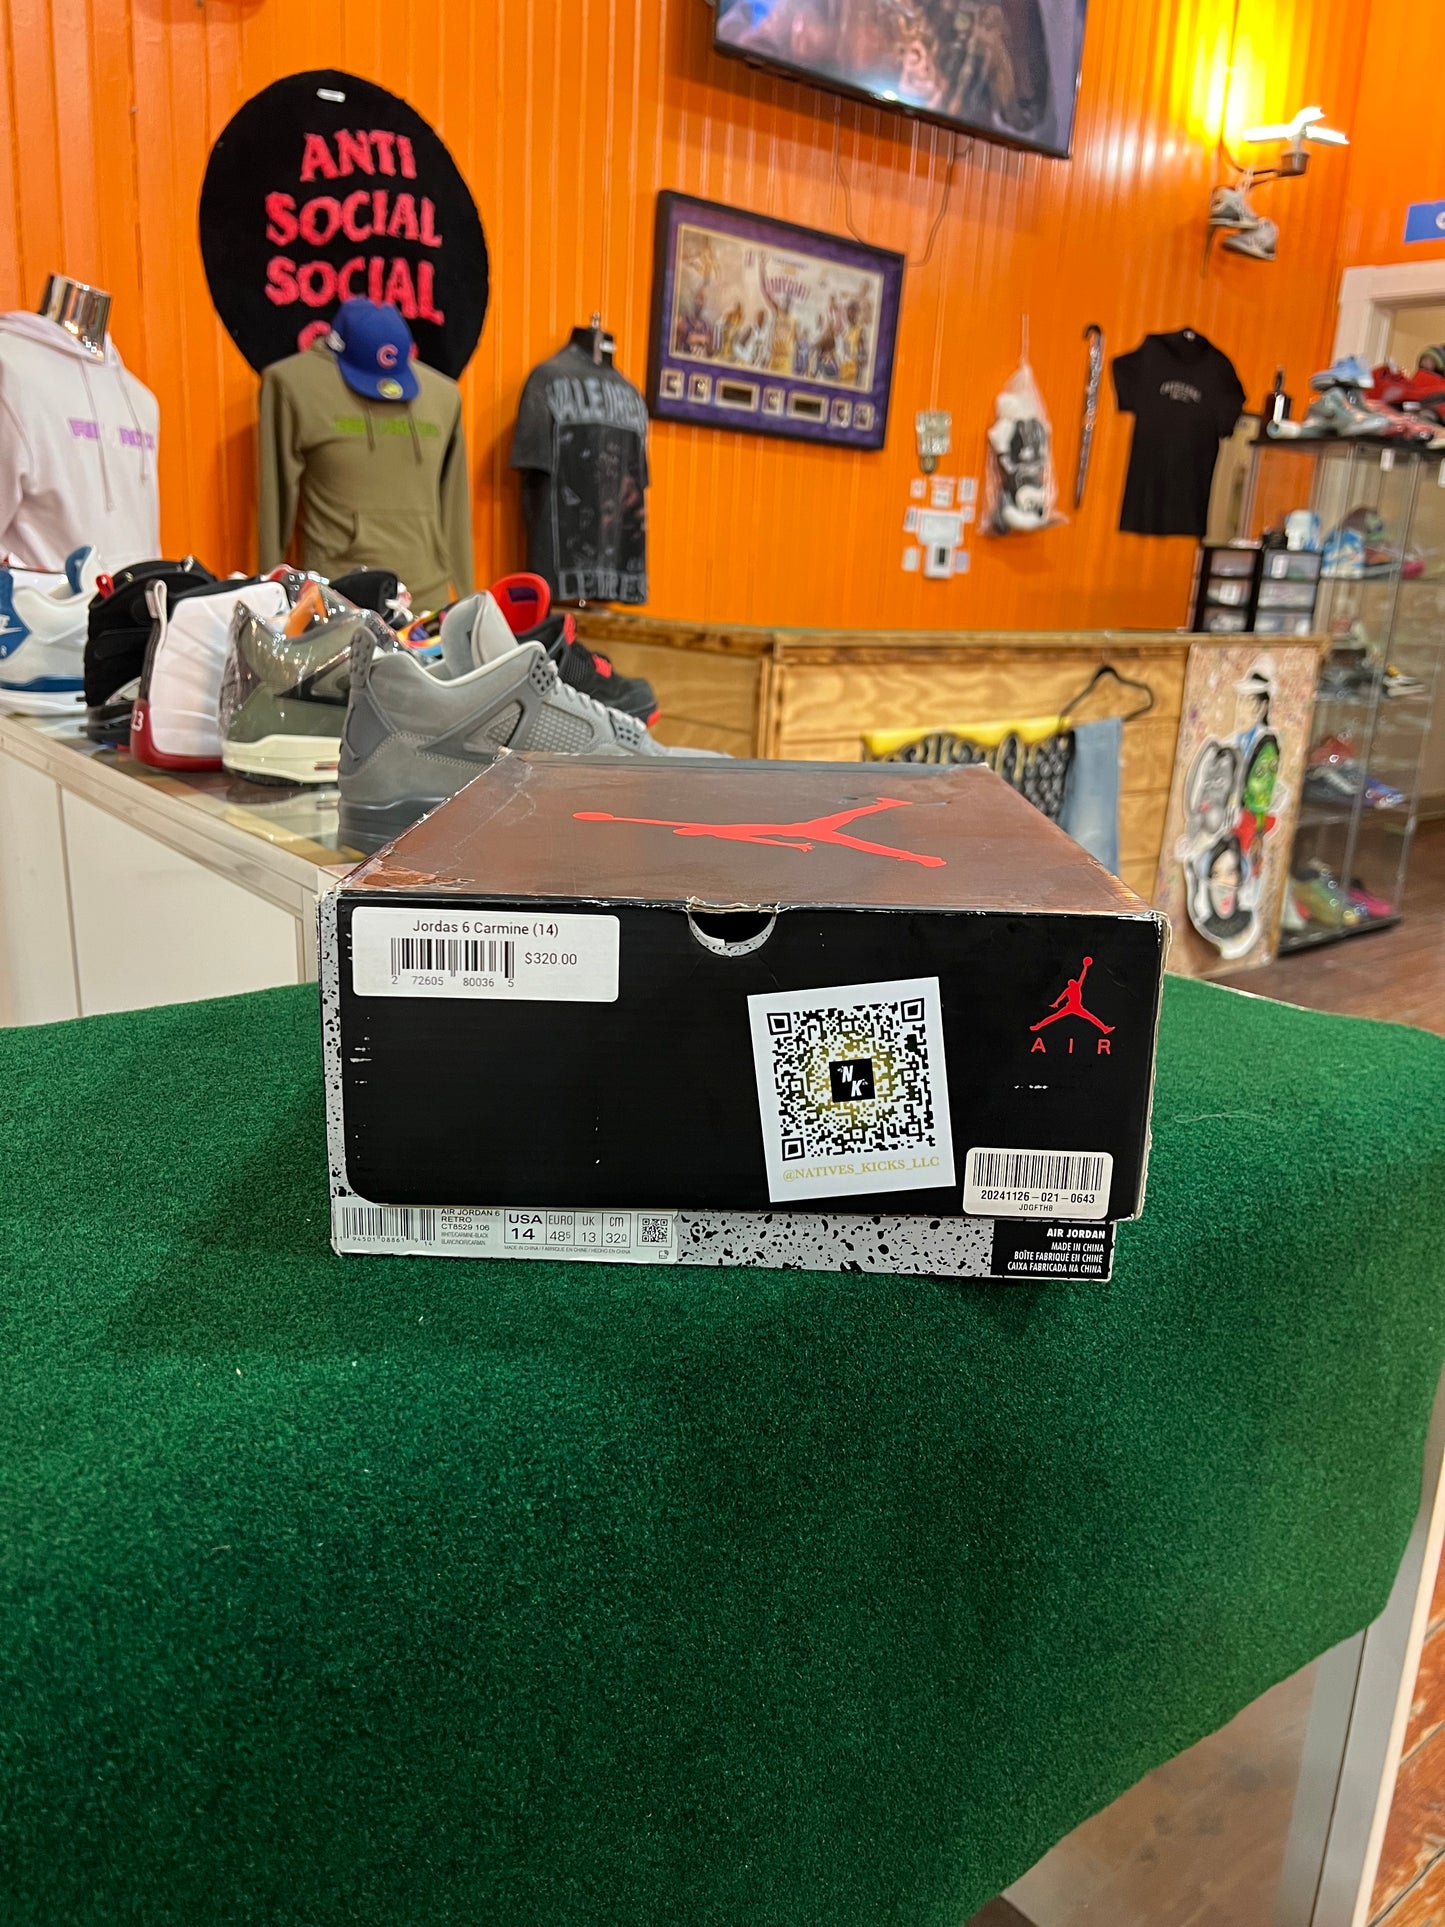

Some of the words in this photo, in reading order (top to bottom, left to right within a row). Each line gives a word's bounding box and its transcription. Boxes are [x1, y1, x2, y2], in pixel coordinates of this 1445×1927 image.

[300, 128, 418, 182] ANTI
[265, 189, 443, 248] SOCIAL
[265, 255, 445, 326] SOCIAL
[412, 920, 458, 933] Jordas
[462, 922, 470, 934] 6
[474, 922, 529, 936] Carmine
[533, 923, 559, 938] (14)
[524, 953, 577, 966] $320.00
[391, 976, 398, 985] 2
[412, 976, 444, 986] 72605
[463, 977, 495, 987] 80036
[507, 978, 514, 988] 5
[1030, 1037, 1111, 1055] AIR
[782, 1156, 940, 1182] @NATIVES_KICKS_LLC
[441, 1208, 455, 1216] AIR
[441, 1215, 473, 1223] RETRO
[508, 1214, 543, 1225] USA
[548, 1215, 573, 1226] EURO
[582, 1216, 595, 1226] UK
[441, 1223, 473, 1231] CT8529
[475, 1224, 490, 1232] 106
[1046, 1228, 1064, 1238] AIR
[1066, 1229, 1106, 1239] JORDAN
[511, 1228, 536, 1241] 14
[582, 1232, 597, 1243] 13
[1051, 1242, 1072, 1251] MADE
[1072, 1242, 1082, 1252] IN
[1082, 1243, 1105, 1253] CHINA
[1014, 1250, 1034, 1261] BOÎTE
[1070, 1254, 1081, 1262] EN
[1081, 1254, 1103, 1263] CHINE
[1007, 1261, 1028, 1271] CAIXA
[1029, 1262, 1067, 1272] FABRICADA
[1068, 1264, 1079, 1273] NA
[1079, 1265, 1102, 1274] CHINA
